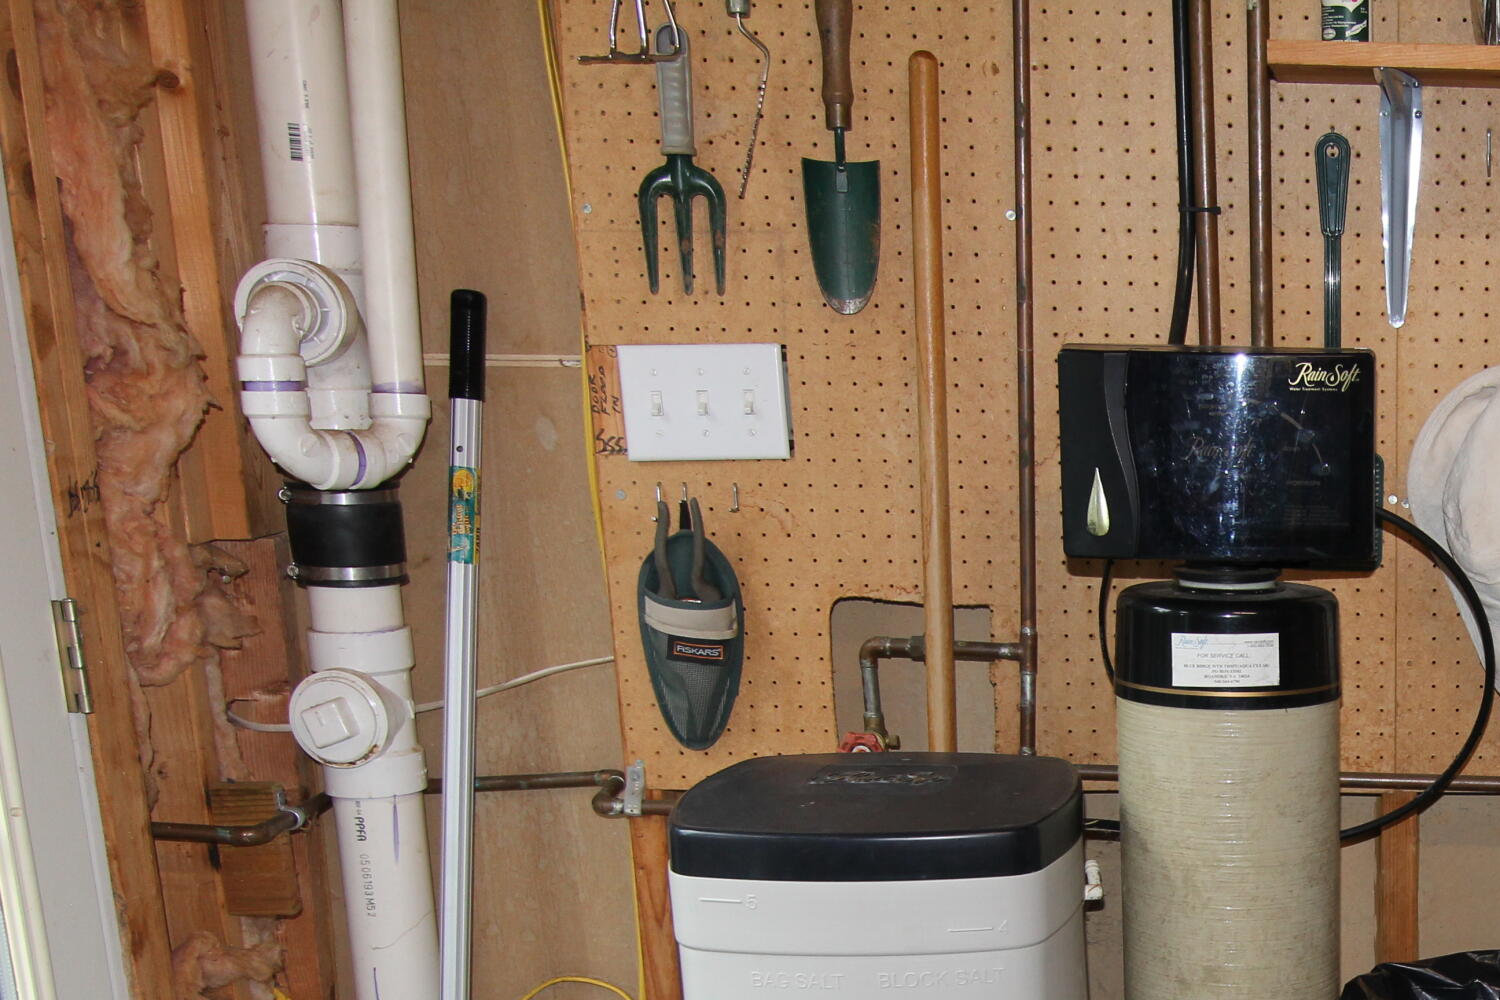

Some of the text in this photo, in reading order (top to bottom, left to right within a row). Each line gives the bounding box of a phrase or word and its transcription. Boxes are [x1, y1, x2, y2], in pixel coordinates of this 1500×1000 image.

[676, 645, 721, 656] FISKARS
[744, 893, 758, 910] 5
[751, 970, 846, 990] BAG SALT
[879, 967, 1005, 989] BLOCK SALT
